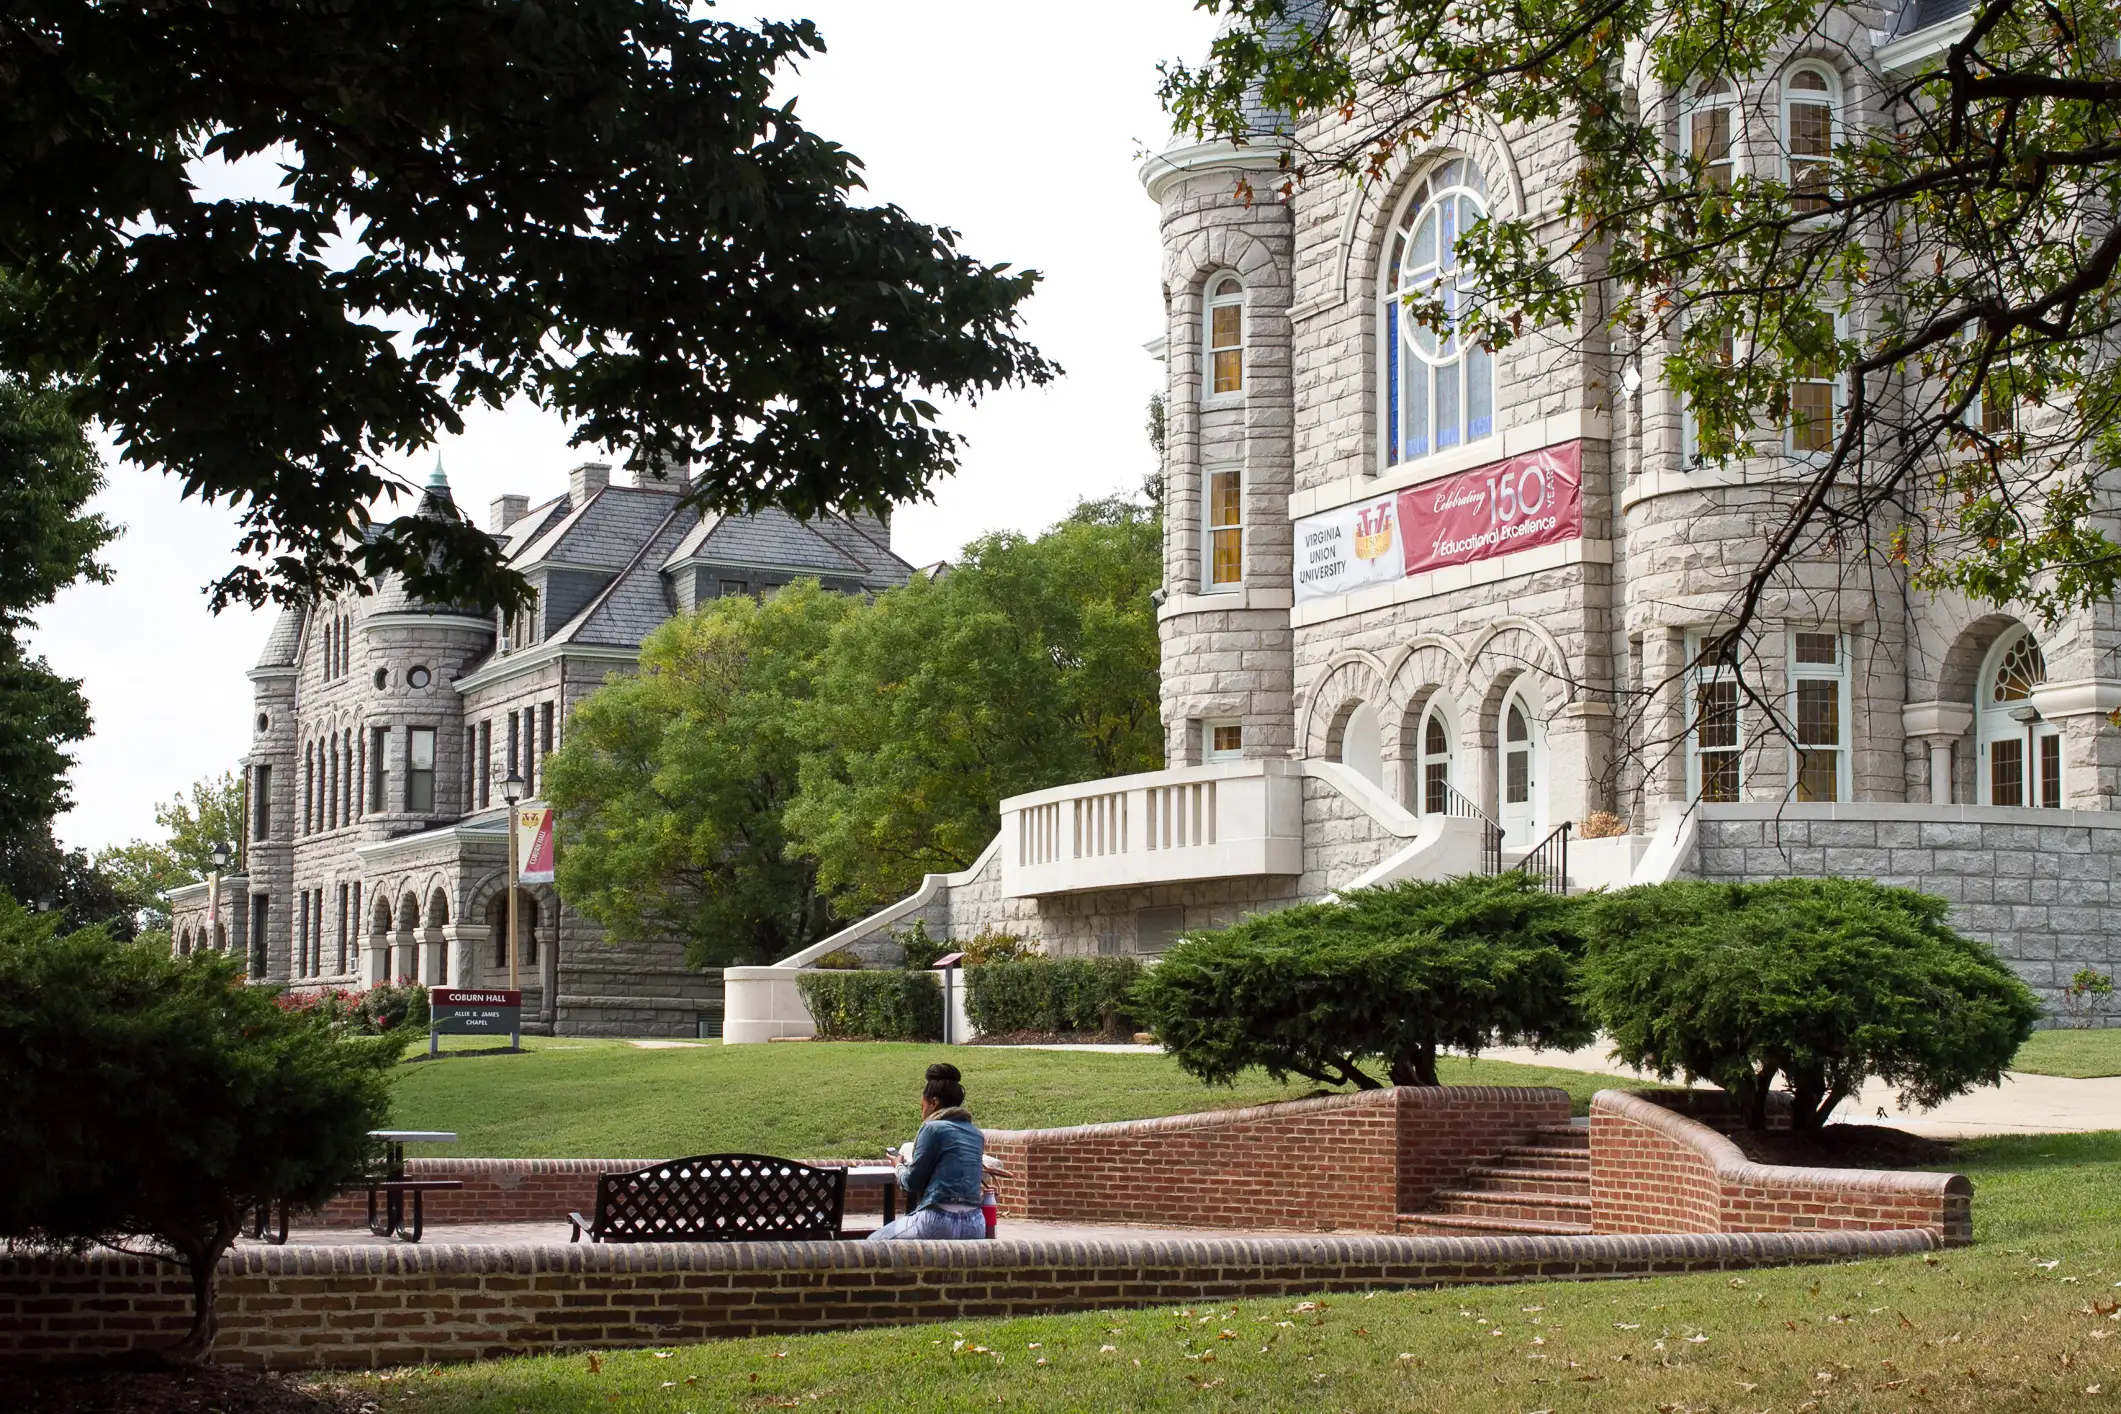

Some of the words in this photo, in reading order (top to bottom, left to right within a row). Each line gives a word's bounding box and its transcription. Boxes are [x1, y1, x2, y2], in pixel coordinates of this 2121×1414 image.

[1433, 486, 1486, 516] Celebrating
[1486, 465, 1546, 525] 150
[1305, 526, 1342, 548] VIRGINIA
[1440, 528, 1499, 556] Educational
[1501, 515, 1556, 541] Excellence
[1309, 545, 1336, 564] UNION
[1299, 560, 1346, 584] UNIVERSITY
[448, 993, 484, 1002] COBURN
[485, 994, 507, 1003] HALL
